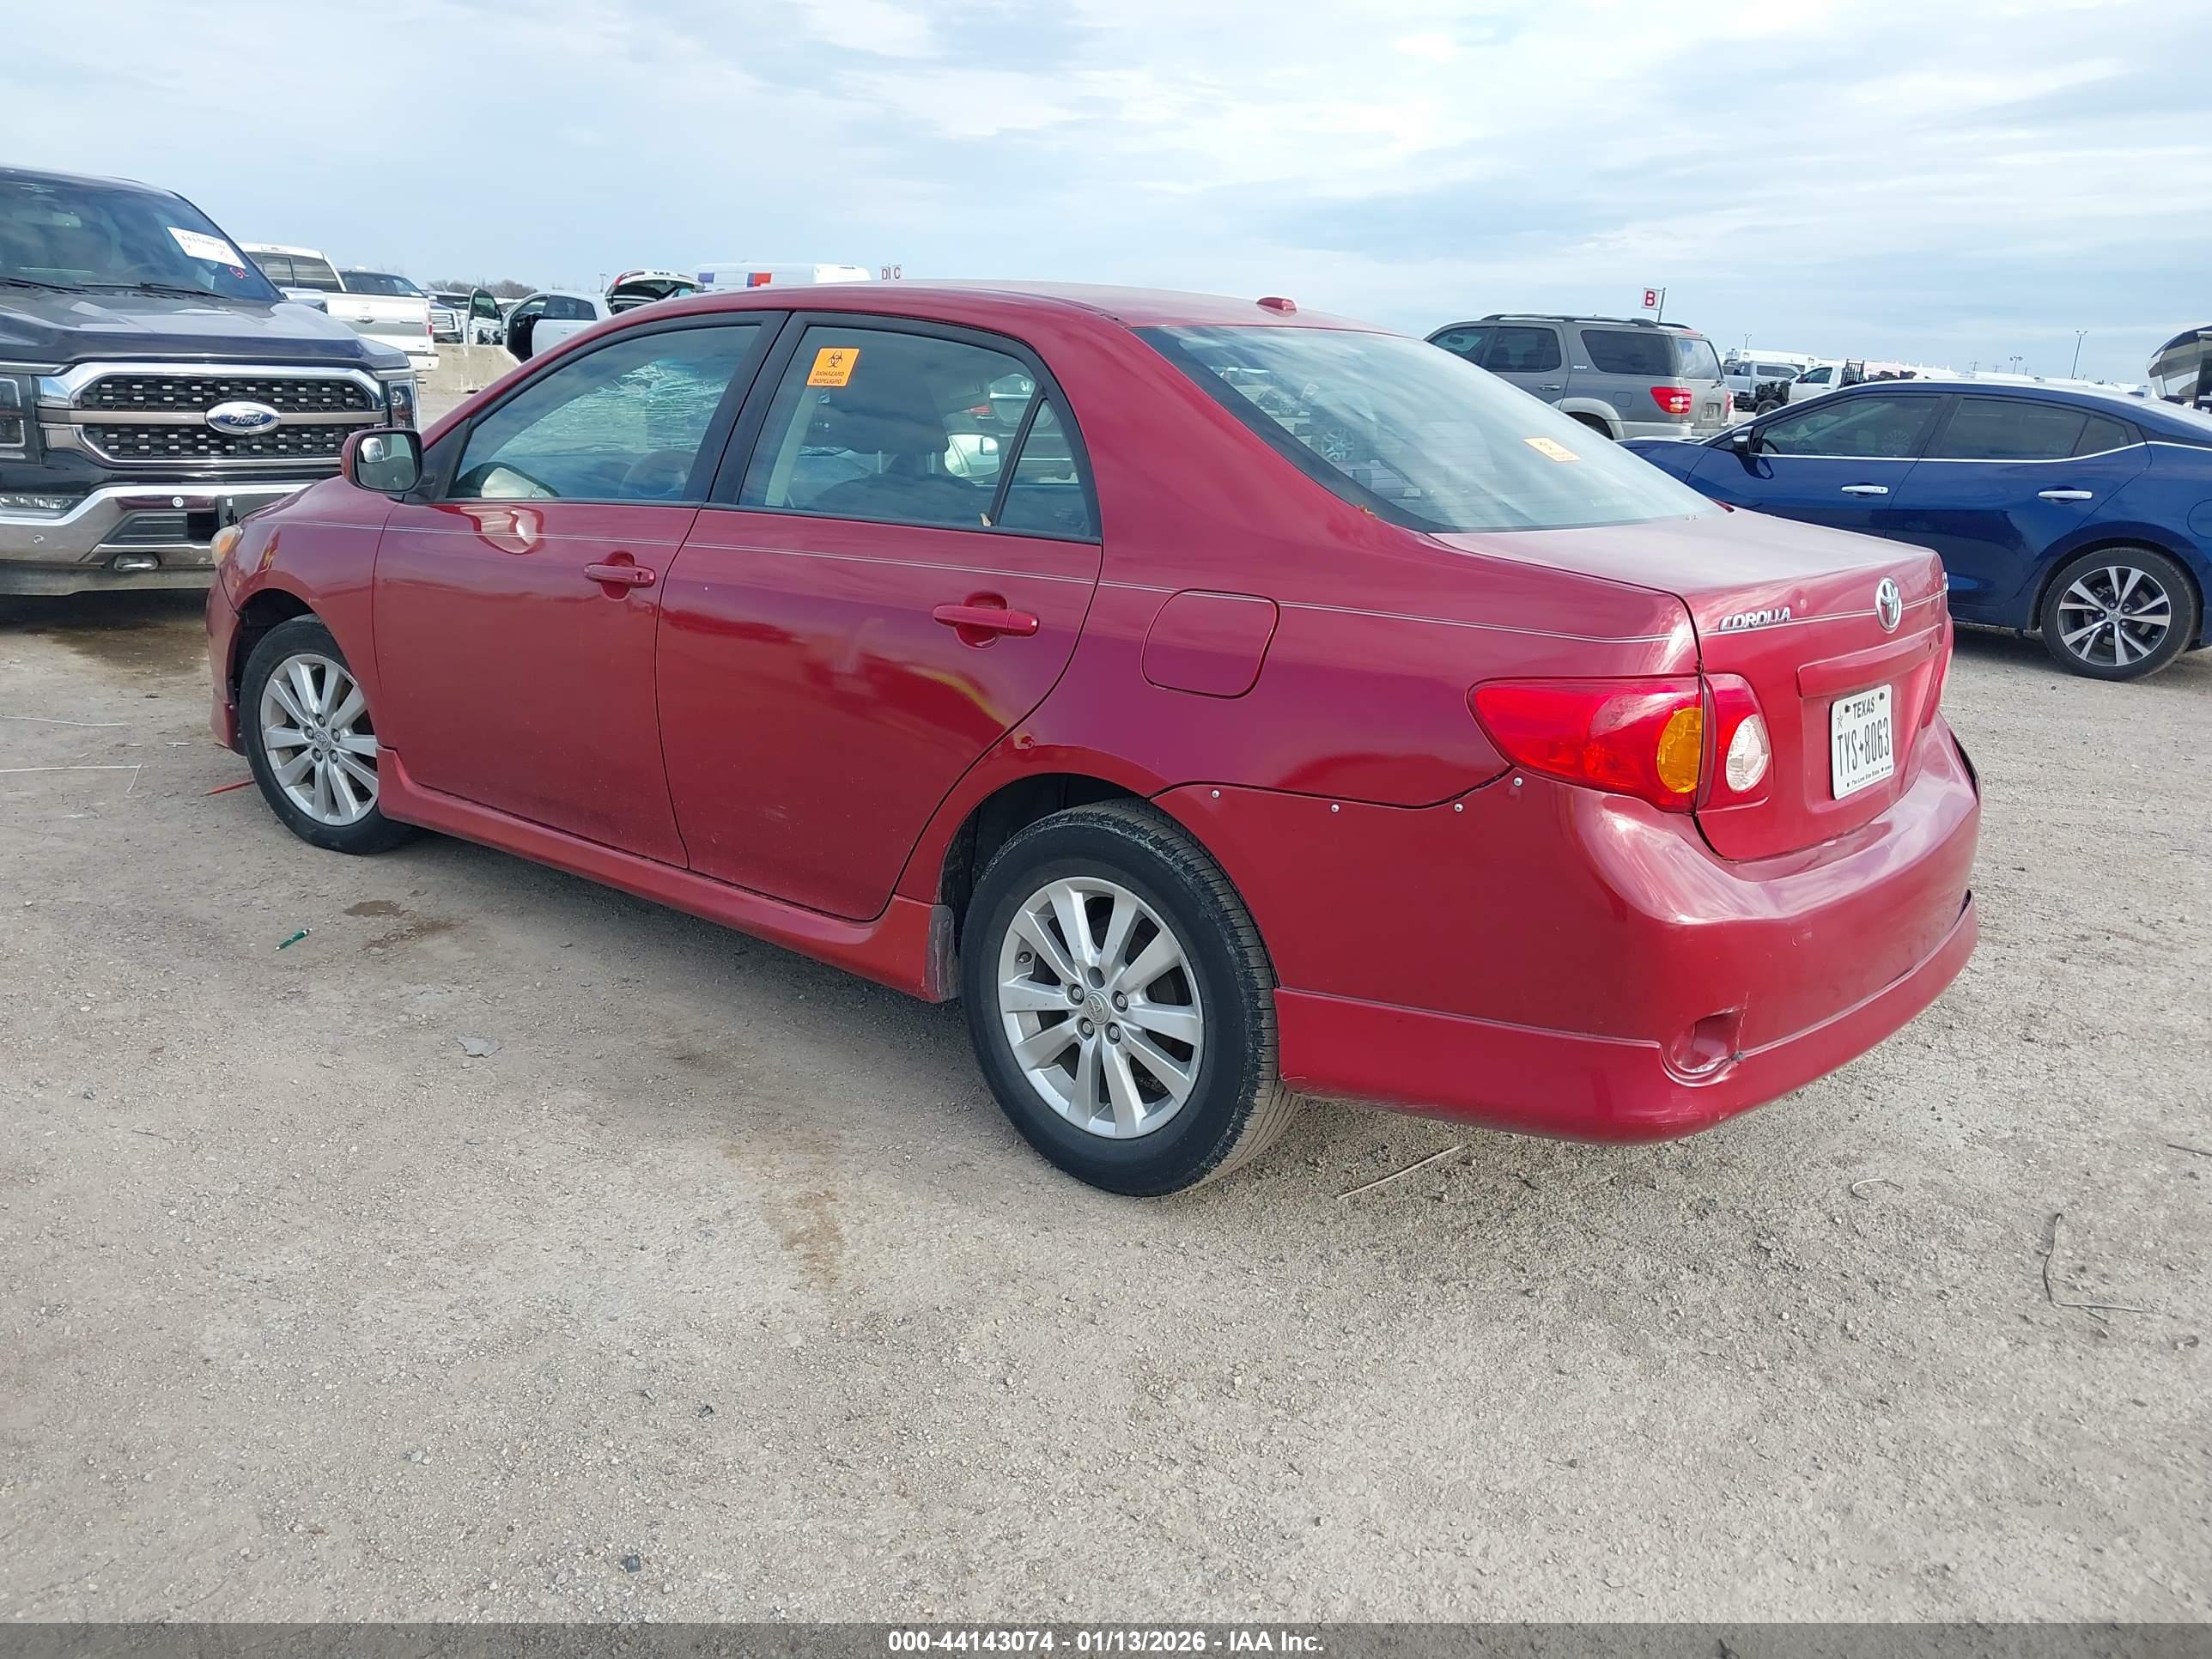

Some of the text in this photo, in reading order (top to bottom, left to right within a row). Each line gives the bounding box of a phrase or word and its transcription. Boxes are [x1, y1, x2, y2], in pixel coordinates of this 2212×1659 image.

[1645, 290, 1656, 307] B
[229, 413, 264, 424] Ford
[1718, 606, 1791, 632] COROLLA
[1852, 696, 1875, 720] TEXAS
